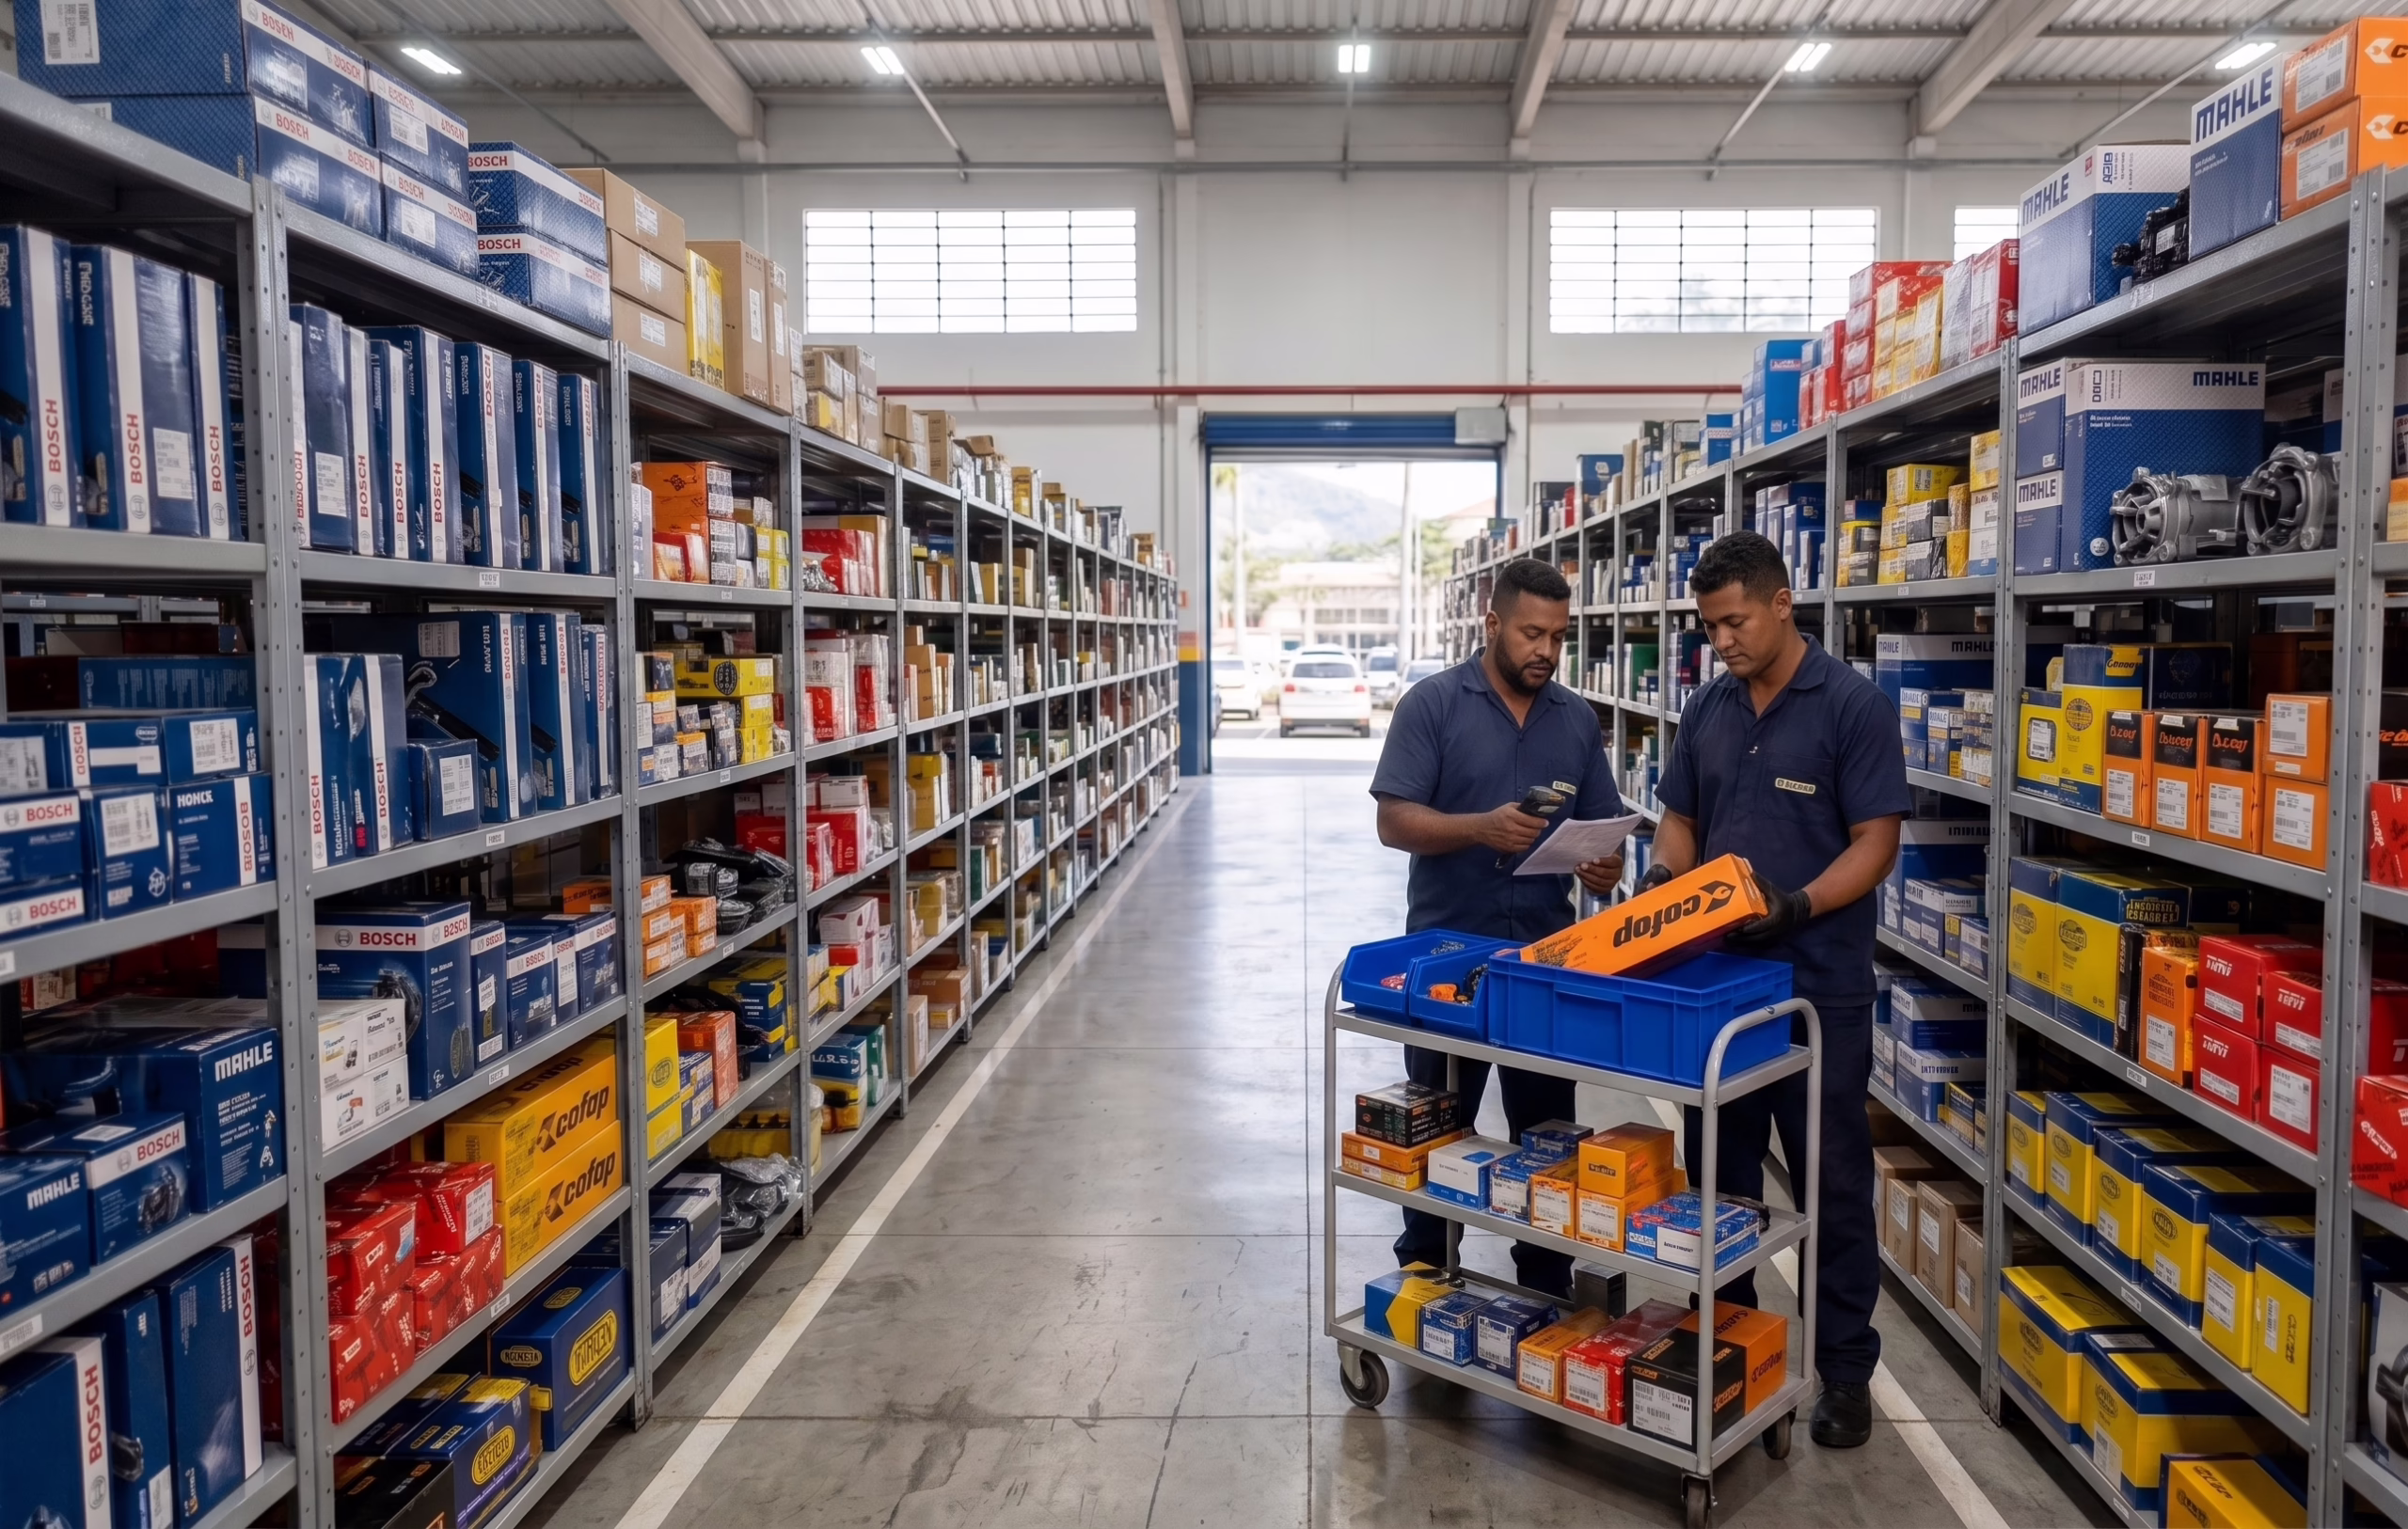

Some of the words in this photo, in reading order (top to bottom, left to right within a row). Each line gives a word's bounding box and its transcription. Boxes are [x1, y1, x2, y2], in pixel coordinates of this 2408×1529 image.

[2196, 67, 2273, 143] MAHLE
[2023, 172, 2069, 226] MAHLE
[478, 239, 521, 250] BOSCH
[2020, 367, 2061, 399] MAHLE
[2194, 371, 2258, 386] MAHLE
[46, 399, 61, 473] BOSCH
[127, 414, 143, 484] BOSCH
[209, 426, 222, 492] BOSCH
[357, 455, 369, 518] BOSCH
[395, 462, 404, 523] BOSCH
[433, 463, 443, 523] BOSCH
[2019, 478, 2056, 503] MAHLE
[26, 803, 73, 822] BOSCH
[311, 775, 322, 835] BOSCH
[376, 762, 386, 818] BOSCH
[29, 896, 77, 919] BOSCH
[359, 932, 417, 946] BOSCH
[215, 1040, 273, 1082] MAHLE
[136, 1128, 181, 1161] BOSCH
[27, 1172, 80, 1211] MAHLE
[85, 1364, 103, 1465] BOSCH
